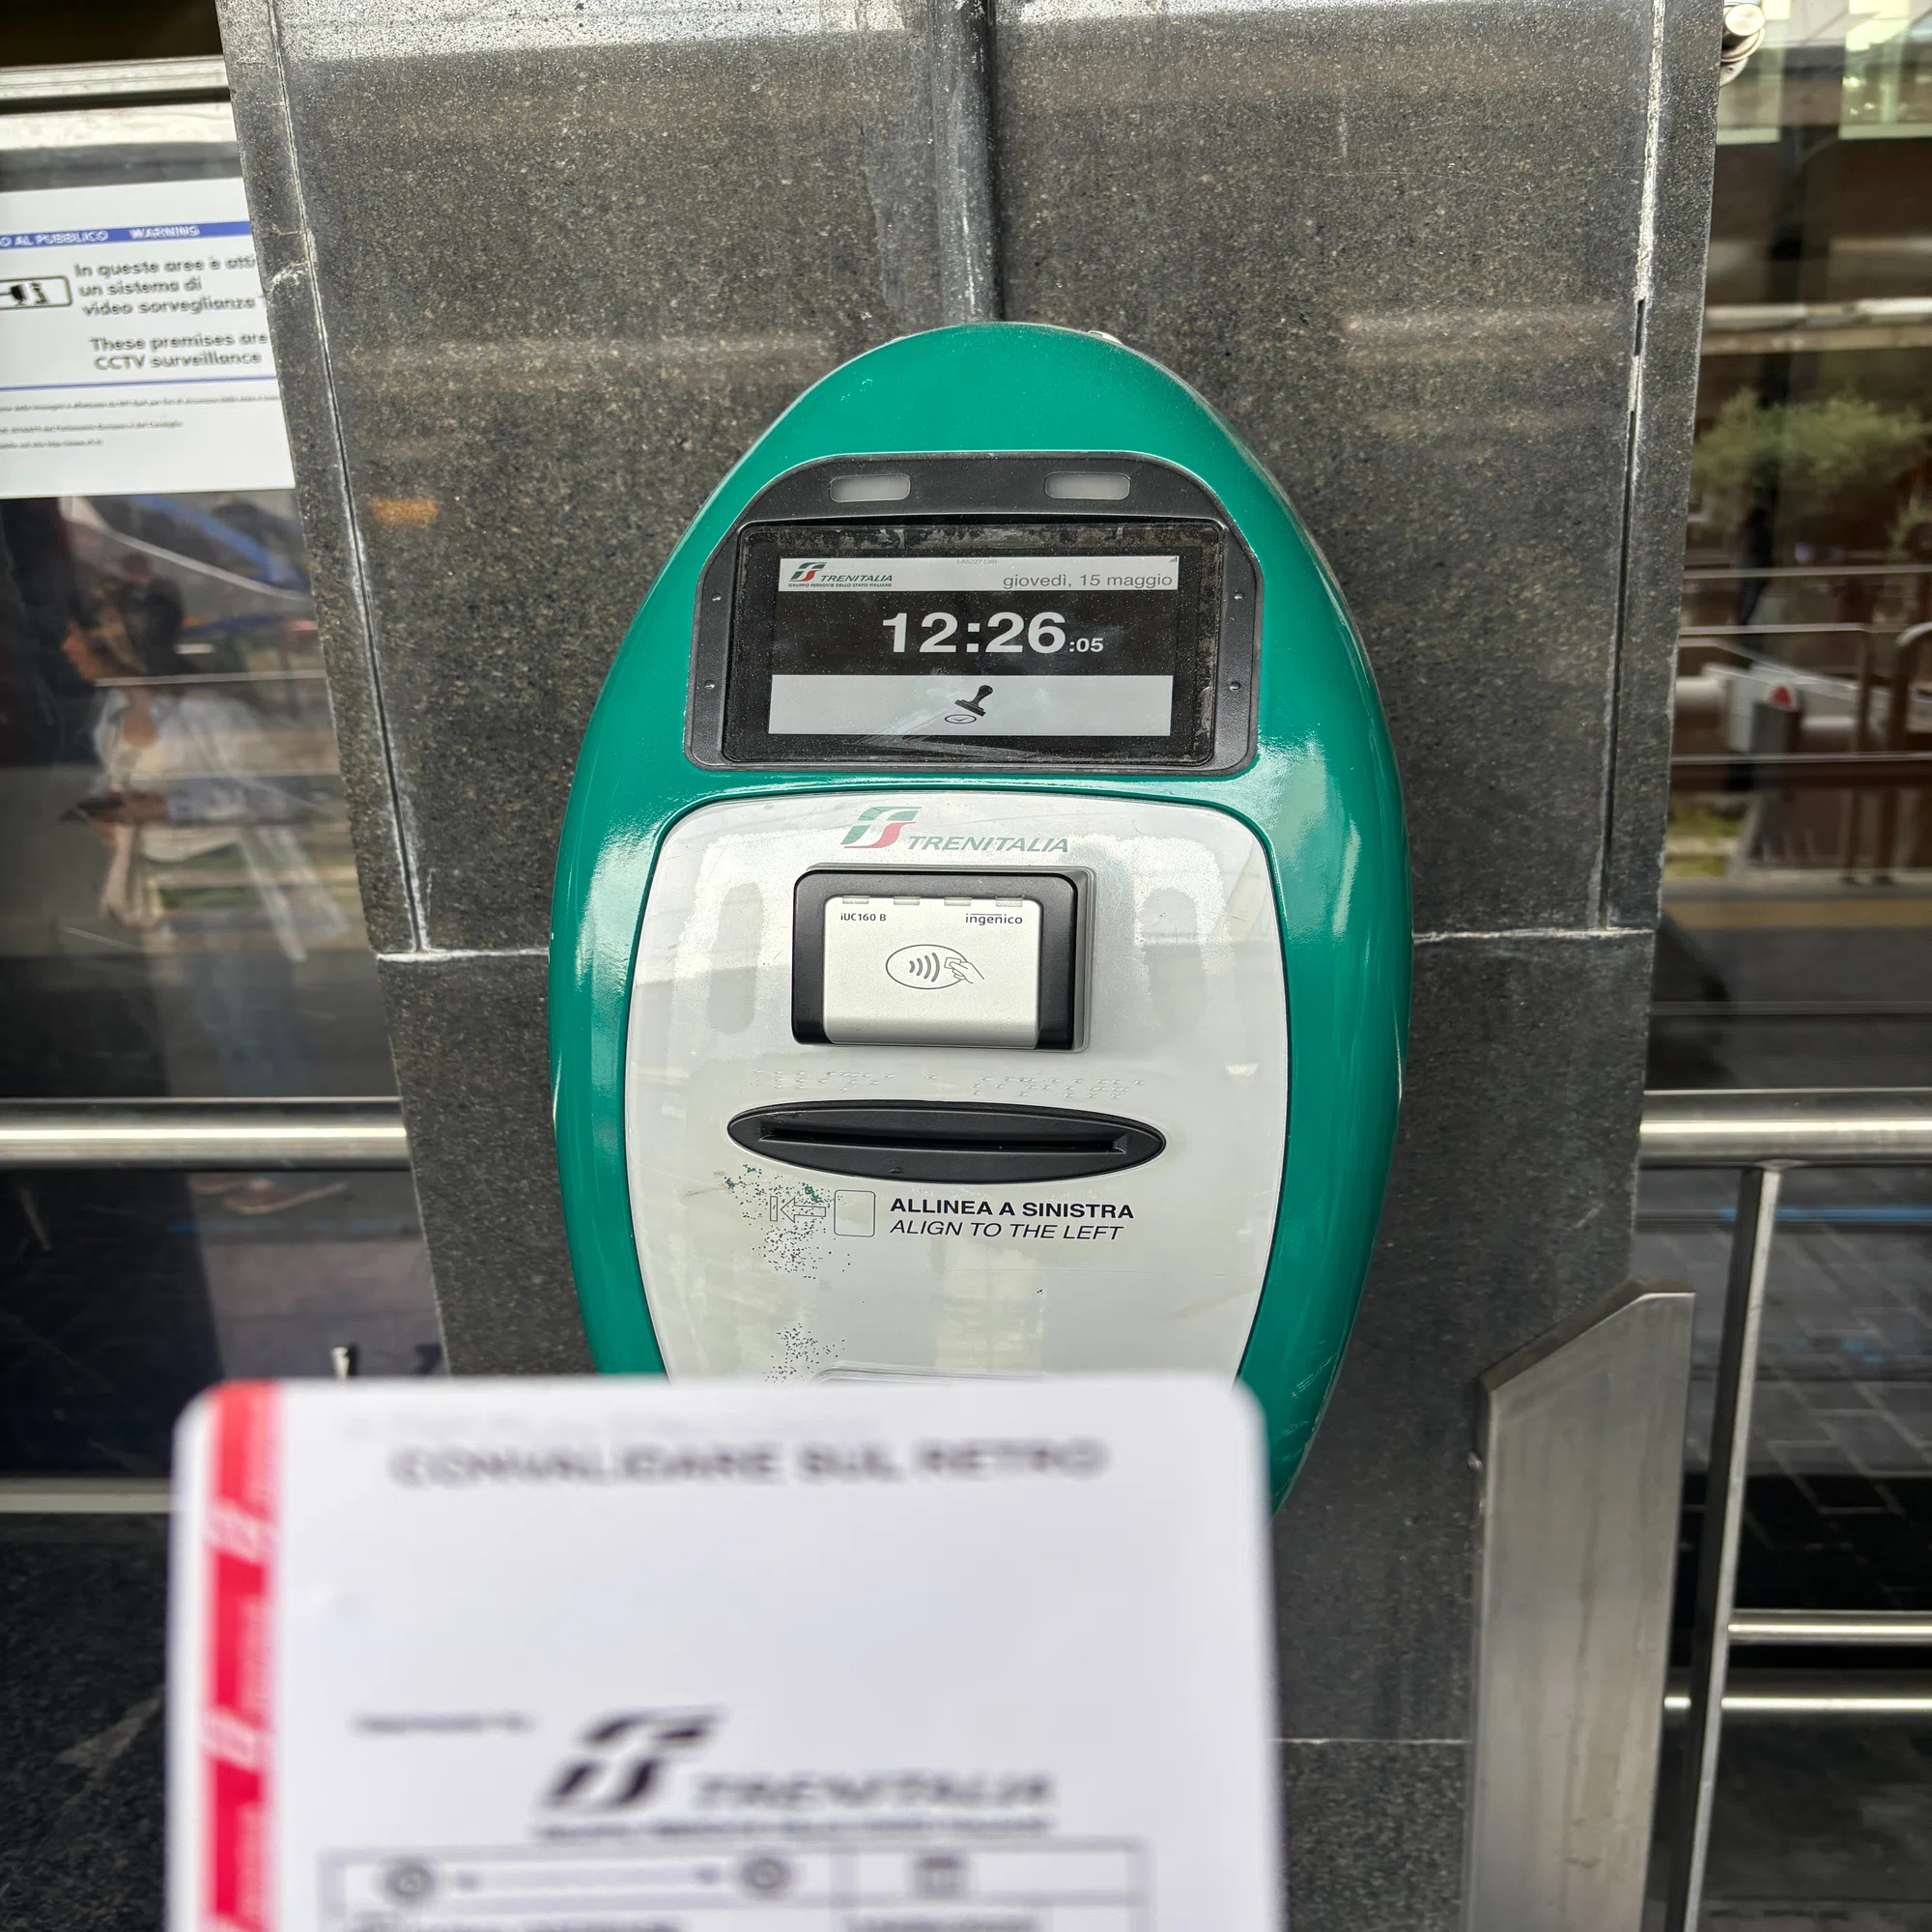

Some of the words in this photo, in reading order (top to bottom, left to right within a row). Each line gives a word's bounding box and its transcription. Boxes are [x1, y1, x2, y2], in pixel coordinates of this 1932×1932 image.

[14, 236, 33, 246] AL
[35, 230, 109, 245] PUBBLICO
[128, 225, 201, 240] WARNING
[73, 262, 93, 277] In
[98, 260, 159, 278] queste
[163, 260, 205, 272] aree
[208, 254, 221, 270] è
[78, 285, 103, 298] un
[107, 279, 180, 295] sistema
[183, 274, 203, 291] di
[82, 300, 133, 316] video
[138, 295, 256, 314] sorveglianza
[89, 335, 146, 352] These
[151, 332, 235, 353] premises
[240, 332, 268, 345] are
[94, 354, 145, 371] CCTV
[151, 350, 263, 368] surveillance
[1003, 574, 1071, 589] giovedì,
[1080, 574, 1101, 586] 15
[1106, 573, 1173, 588] maggio
[882, 611, 1066, 653] 12:26
[908, 835, 1068, 853] TRENITALIA
[840, 913, 876, 922] iUC160
[879, 913, 887, 922] B
[965, 913, 1023, 926] ingenico
[890, 1198, 993, 1215] ALLINEA
[999, 1202, 1015, 1216] A
[1022, 1202, 1134, 1219] SINISTRA
[889, 1219, 963, 1236] ALIGN
[970, 1222, 1002, 1237] TO
[1009, 1223, 1058, 1238] THE
[1063, 1225, 1124, 1240] LEFT
